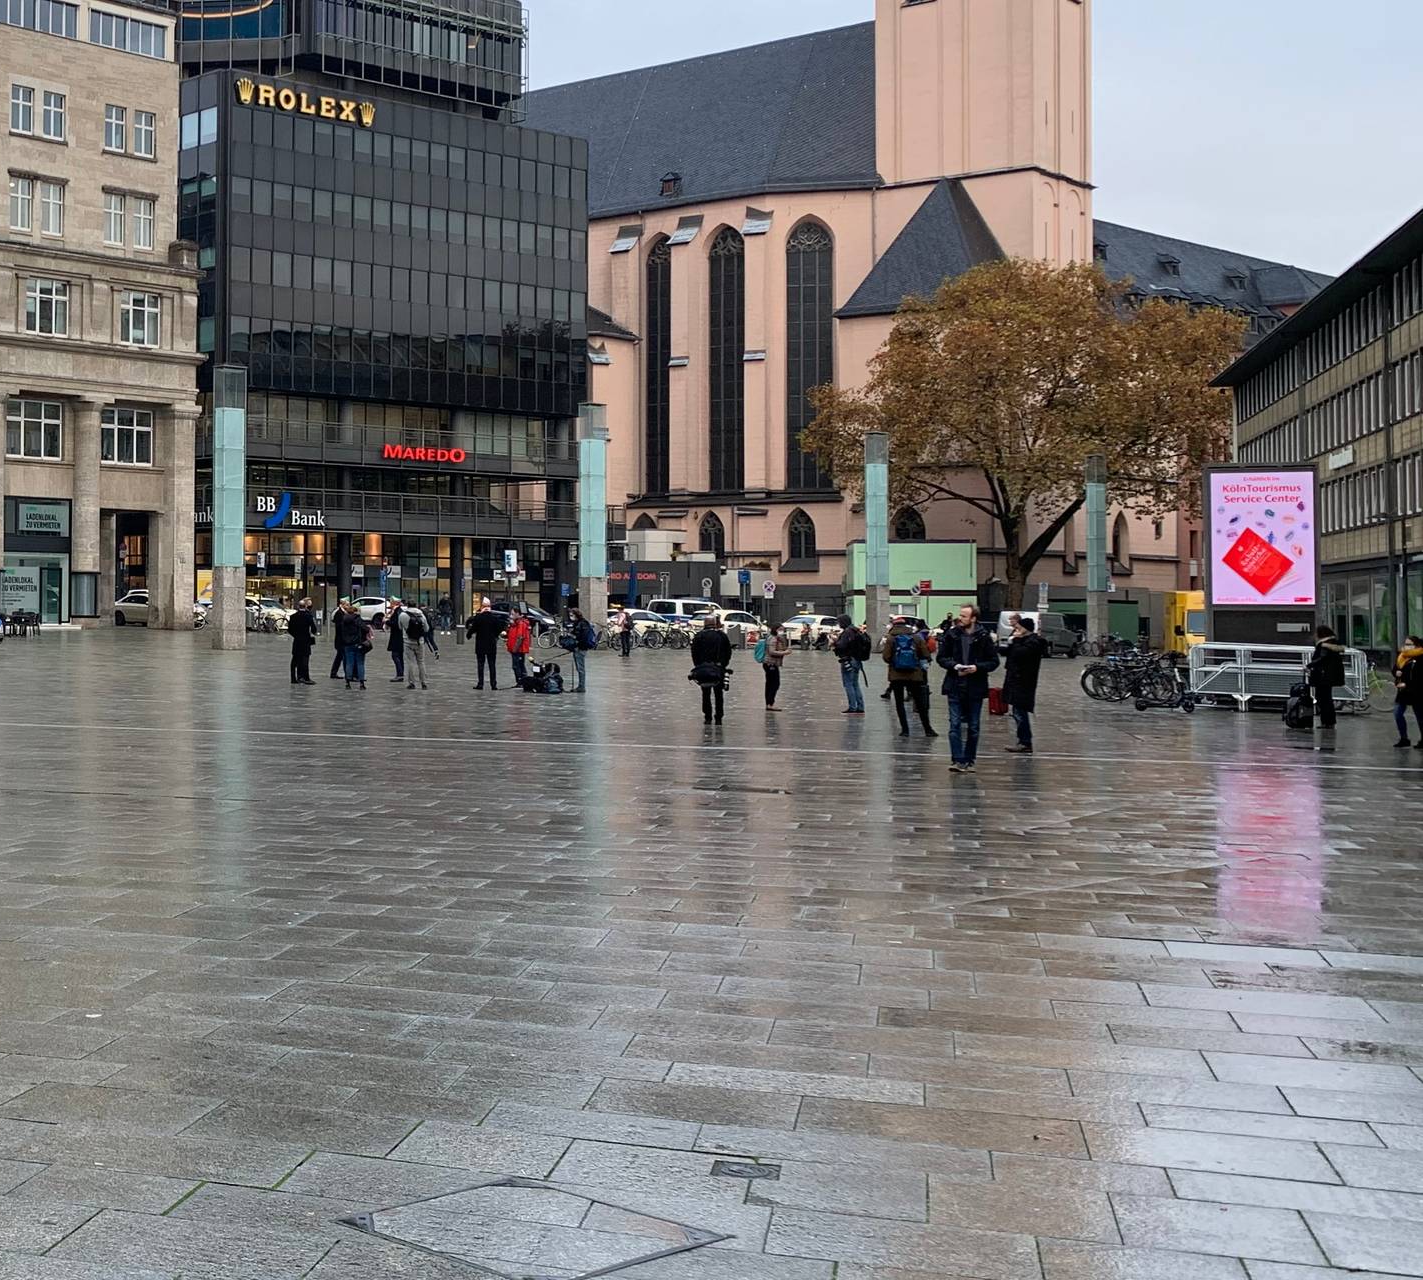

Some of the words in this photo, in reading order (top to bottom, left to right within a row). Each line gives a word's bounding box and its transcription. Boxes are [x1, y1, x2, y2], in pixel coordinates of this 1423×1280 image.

[258, 84, 357, 122] ROLEX
[383, 444, 466, 463] MAREDO
[1222, 484, 1302, 493] KölnTourismus
[1224, 495, 1263, 503] Service
[1264, 494, 1300, 503] Center
[256, 496, 276, 512] BB
[291, 510, 326, 527] Bank
[25, 513, 58, 522] LADENLOKAL
[26, 521, 32, 529] ZU
[33, 521, 61, 530] VERMIETEN
[9, 584, 37, 592] VERMIETEN
